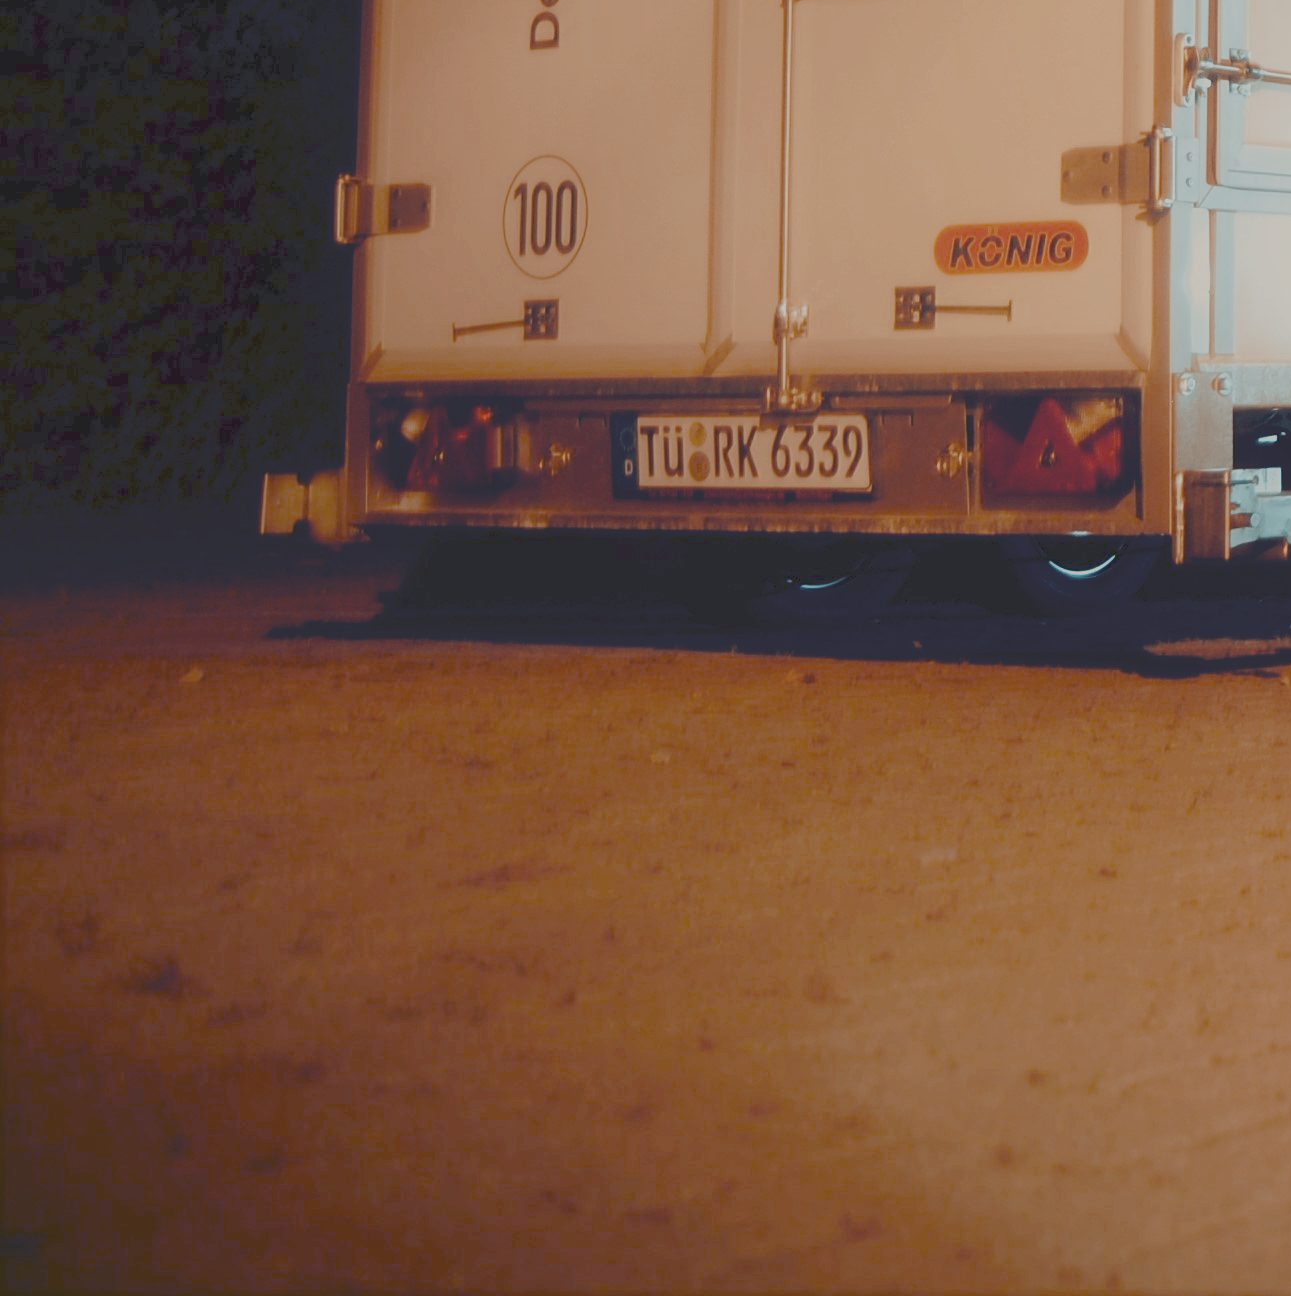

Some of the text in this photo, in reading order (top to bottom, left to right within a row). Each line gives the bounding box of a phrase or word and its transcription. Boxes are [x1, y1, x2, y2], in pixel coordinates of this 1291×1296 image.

[514, 180, 578, 257] 100
[950, 226, 1074, 269] KÖNIG
[624, 458, 634, 476] D
[713, 424, 759, 478] RK
[770, 424, 863, 478] 6339
